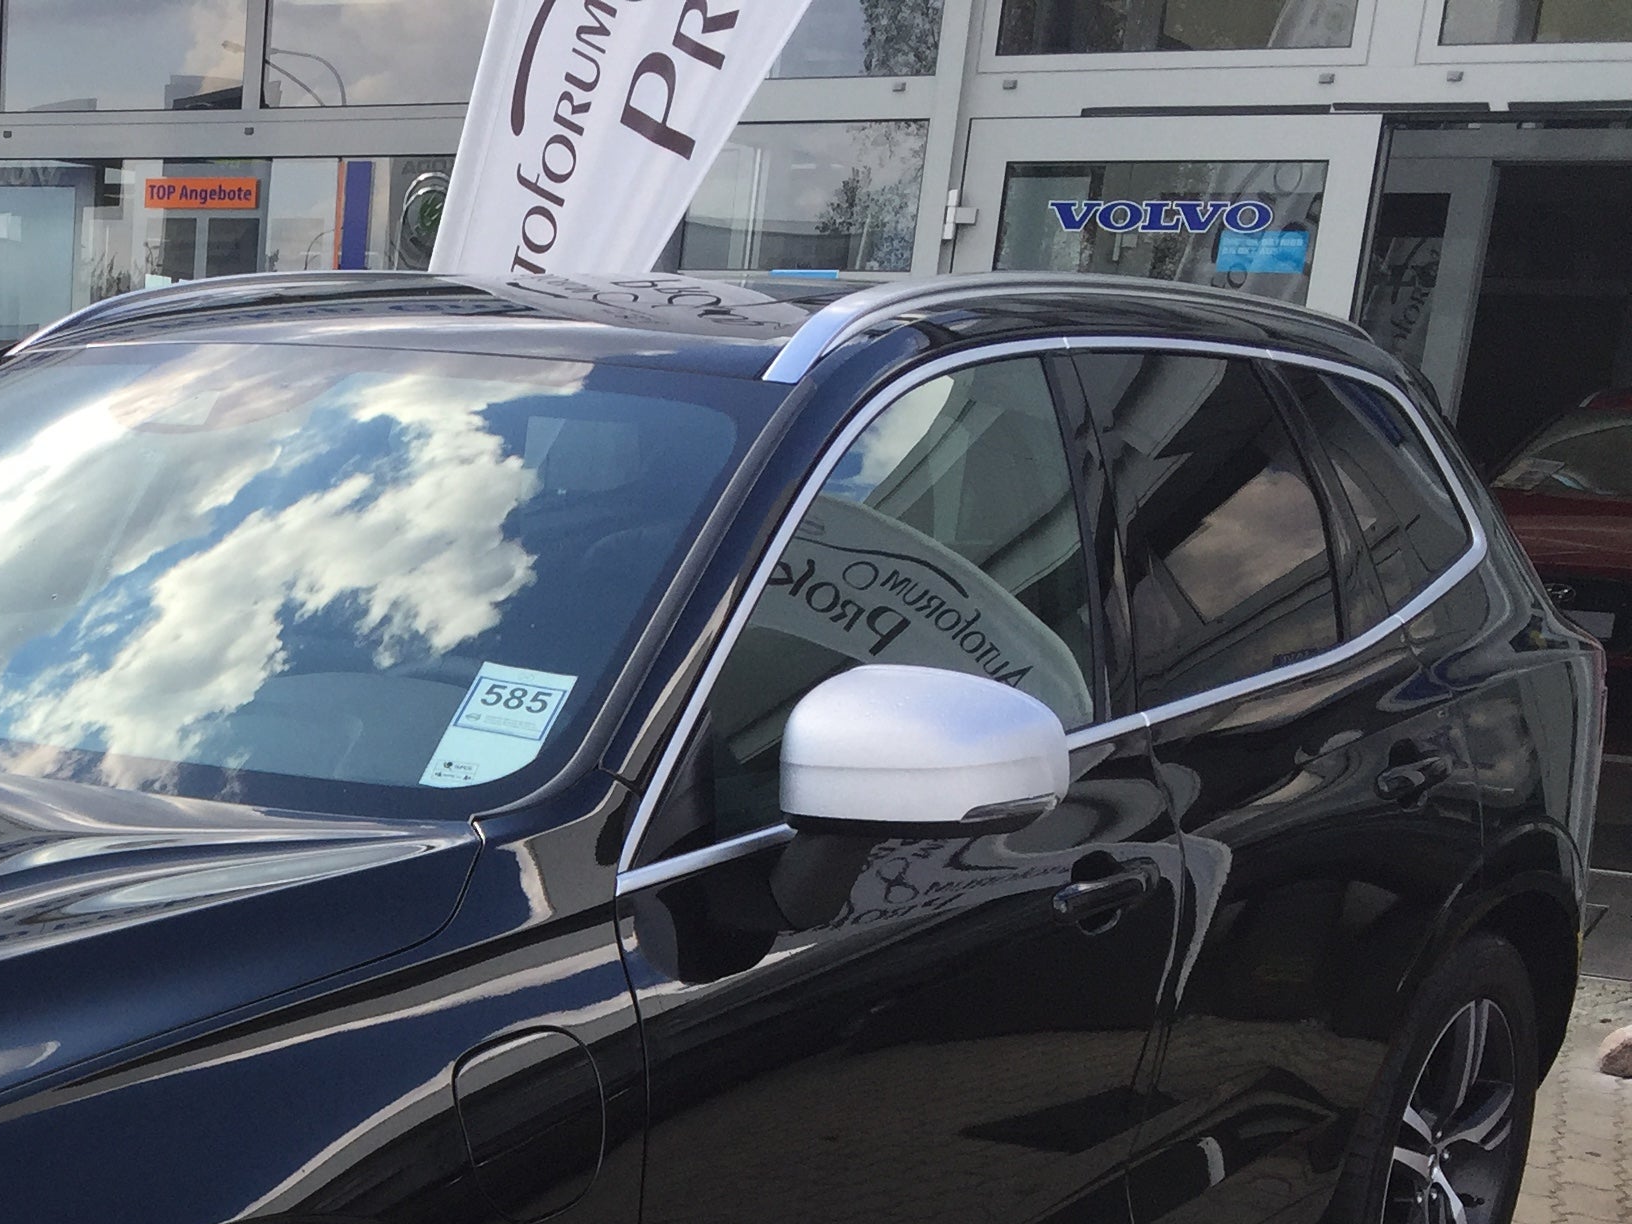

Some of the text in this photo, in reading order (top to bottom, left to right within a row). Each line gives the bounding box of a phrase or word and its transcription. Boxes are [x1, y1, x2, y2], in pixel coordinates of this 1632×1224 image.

[149, 184, 252, 205] TOP Angebote
[1048, 200, 1274, 234] VOLVO
[479, 683, 553, 714] 585
